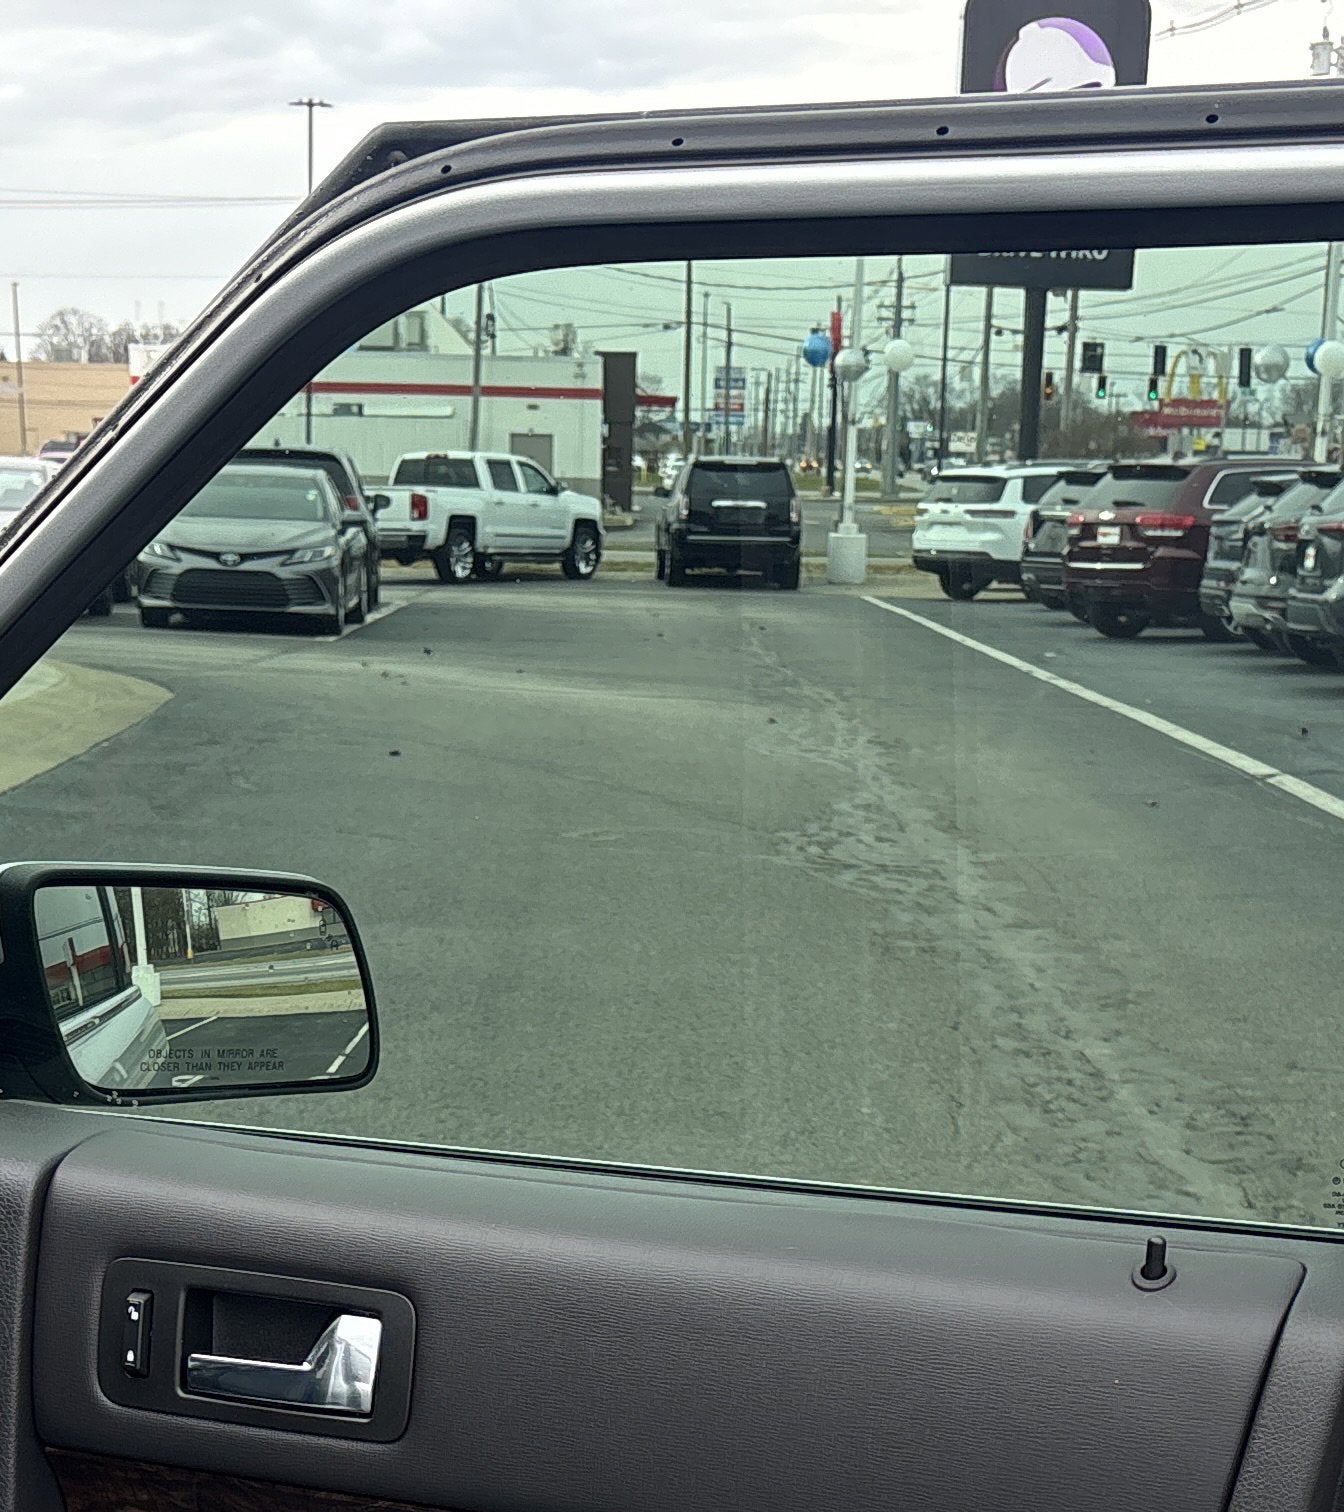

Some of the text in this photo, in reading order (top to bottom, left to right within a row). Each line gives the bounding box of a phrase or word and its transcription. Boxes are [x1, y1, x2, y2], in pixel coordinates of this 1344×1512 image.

[148, 1049, 278, 1059] OBJECTS IN MIRROR ARE
[140, 1061, 285, 1072] CLOSER THAN THEY APPEAR
